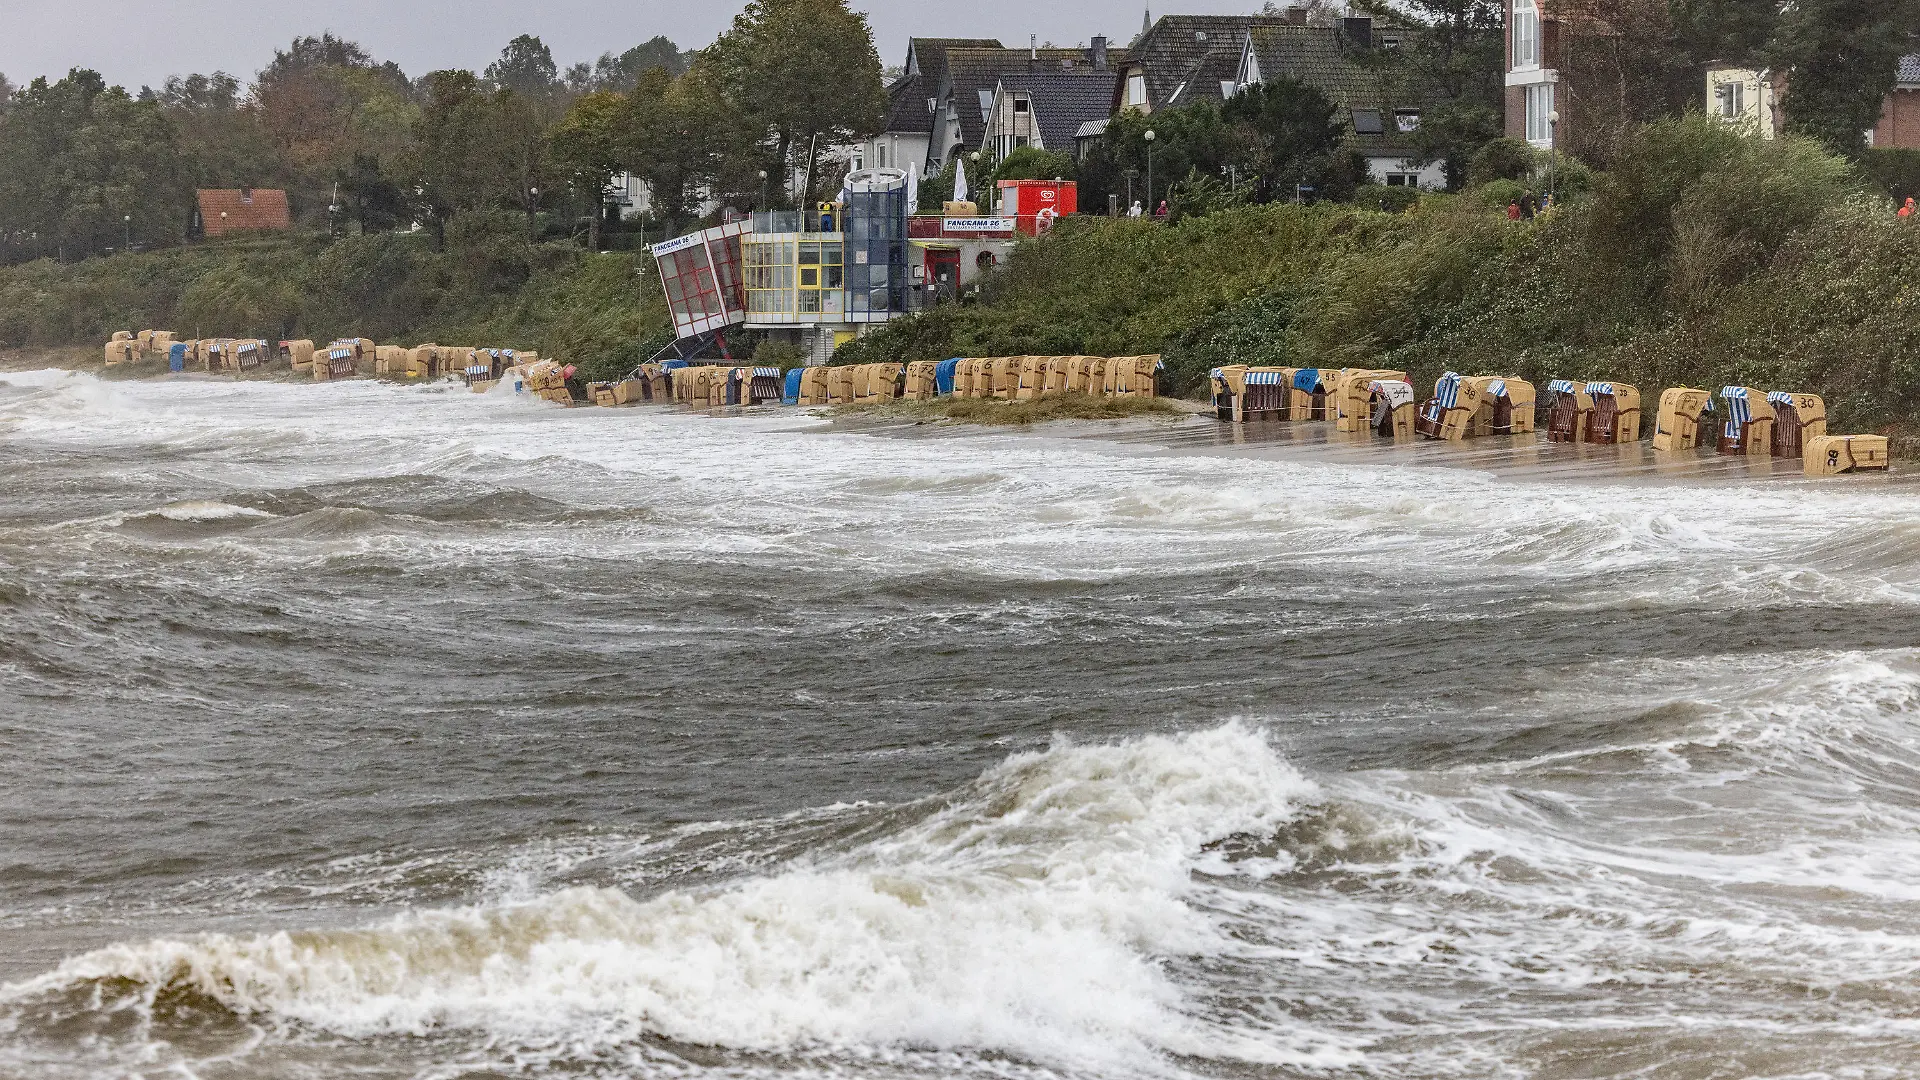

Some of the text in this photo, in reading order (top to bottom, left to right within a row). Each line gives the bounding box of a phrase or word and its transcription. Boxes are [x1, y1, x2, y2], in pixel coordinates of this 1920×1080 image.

[1325, 372, 1336, 382] 55
[1464, 386, 1476, 400] 38
[1800, 397, 1815, 409] 30
